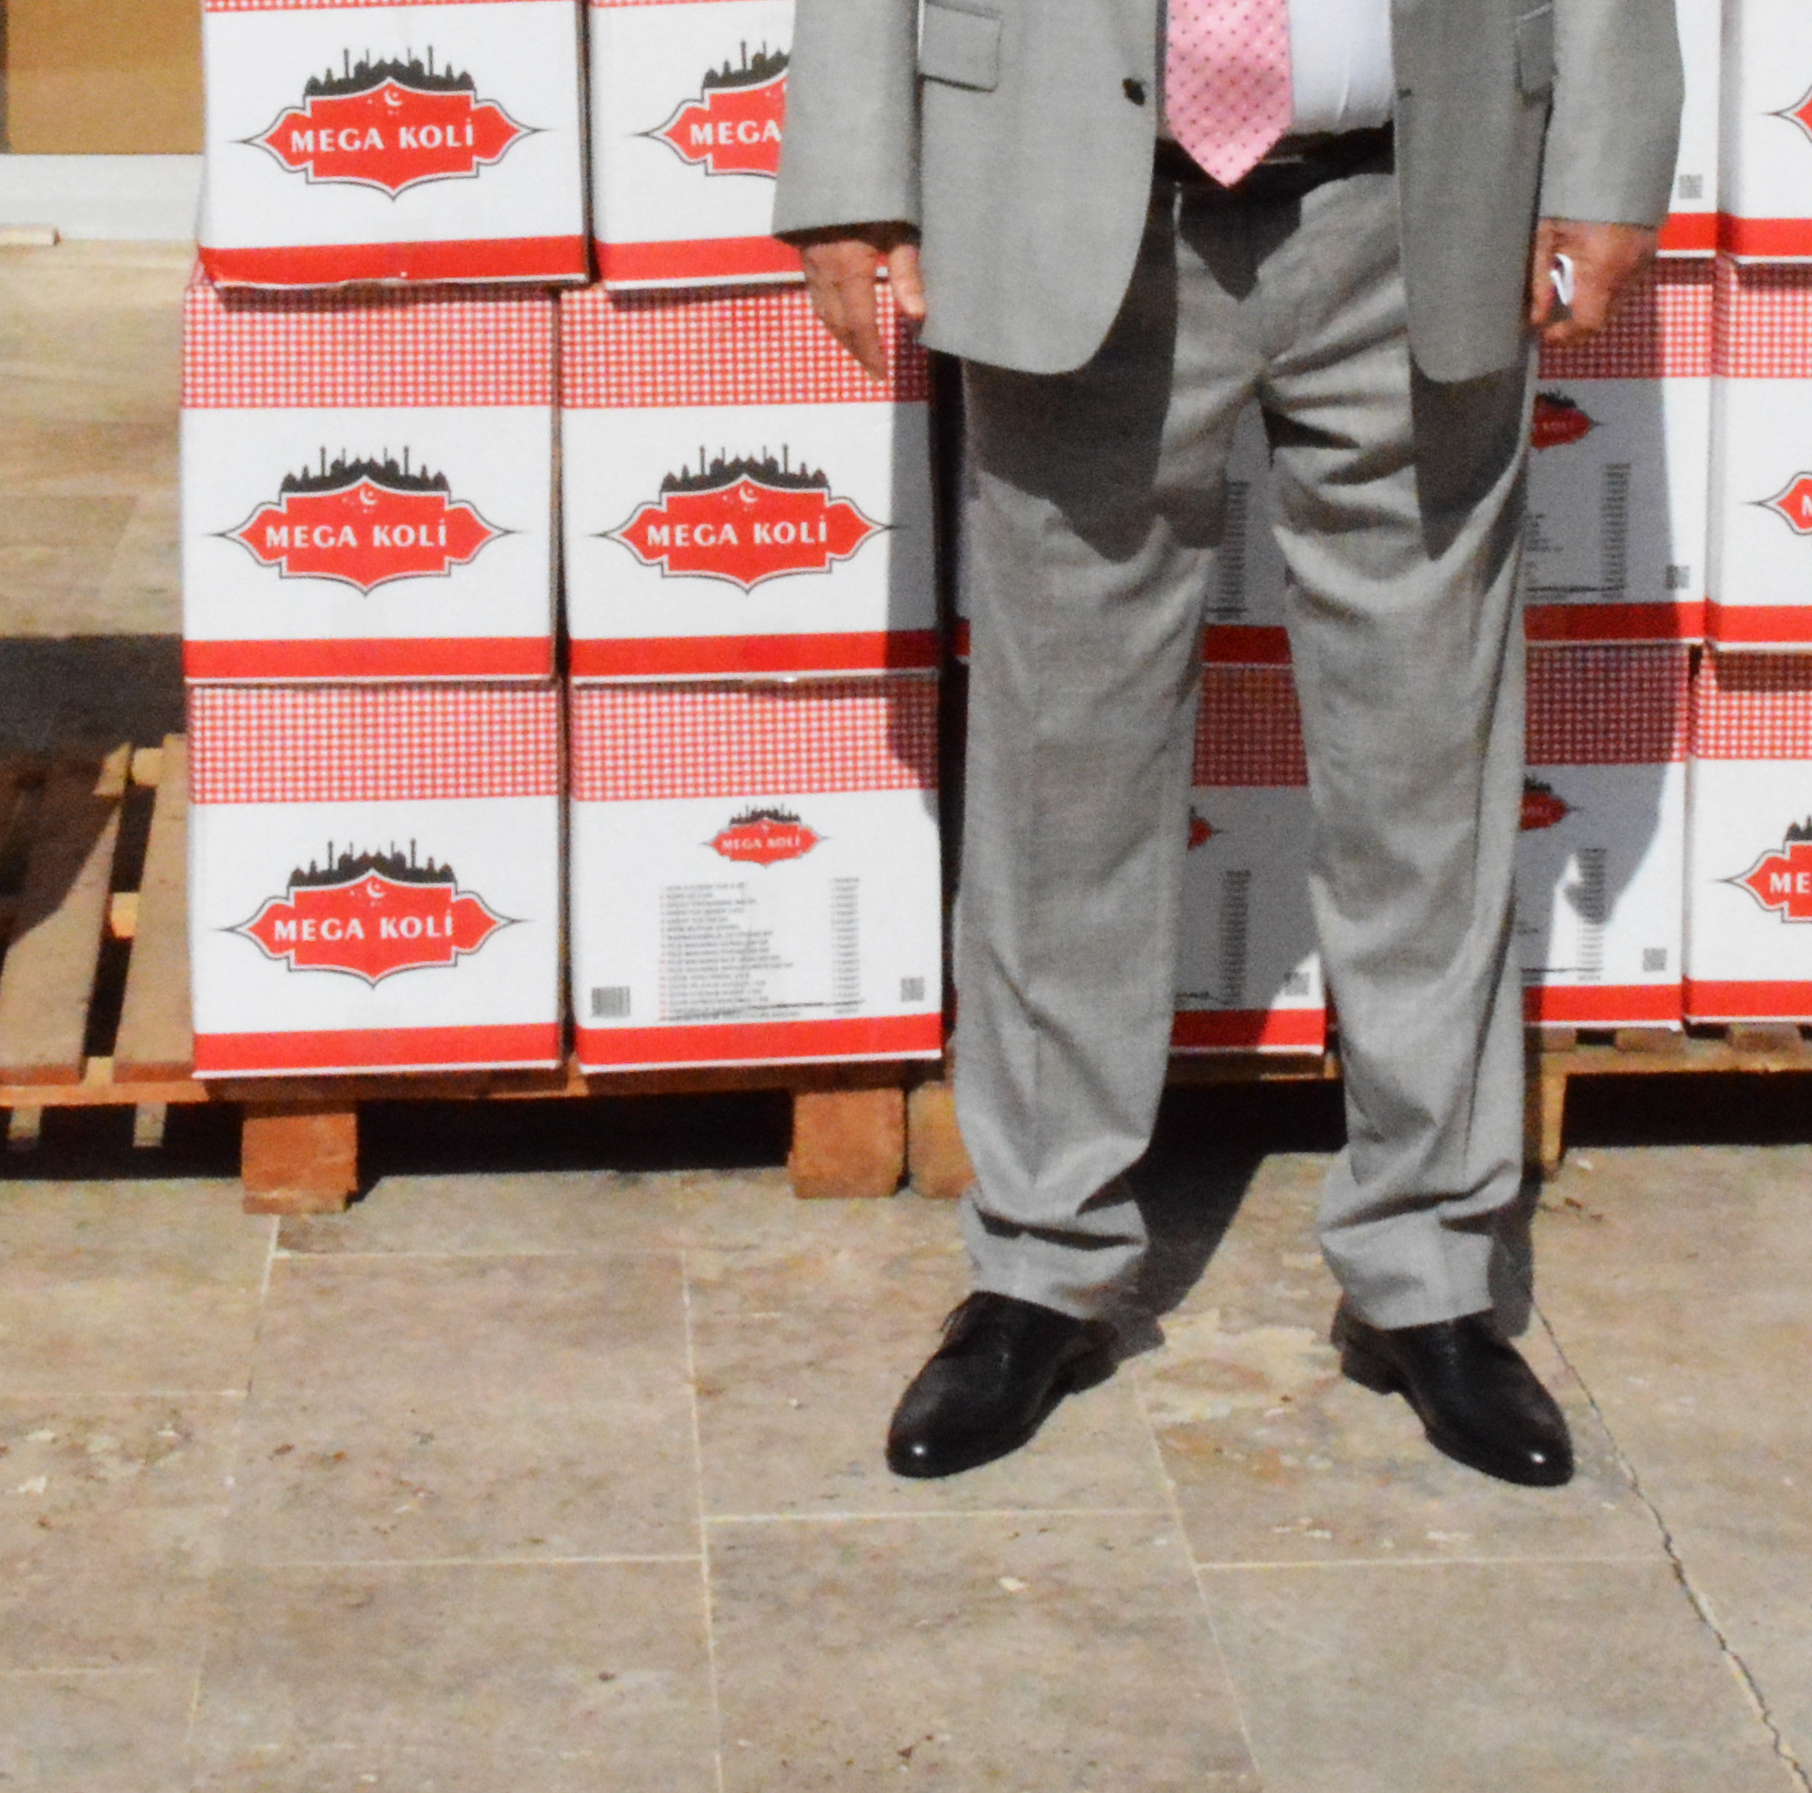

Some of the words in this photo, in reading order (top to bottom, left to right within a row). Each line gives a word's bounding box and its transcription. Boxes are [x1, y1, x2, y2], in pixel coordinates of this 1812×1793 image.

[290, 127, 386, 153] MEGA
[399, 117, 475, 149] KOLİ
[690, 119, 782, 146] MEGA
[265, 525, 358, 549] MEGA
[372, 518, 448, 548] KOLİ
[647, 523, 739, 547] MEGA
[753, 515, 827, 545] KOLİ
[274, 917, 365, 942] MEGA
[379, 909, 454, 940] KOLİ
